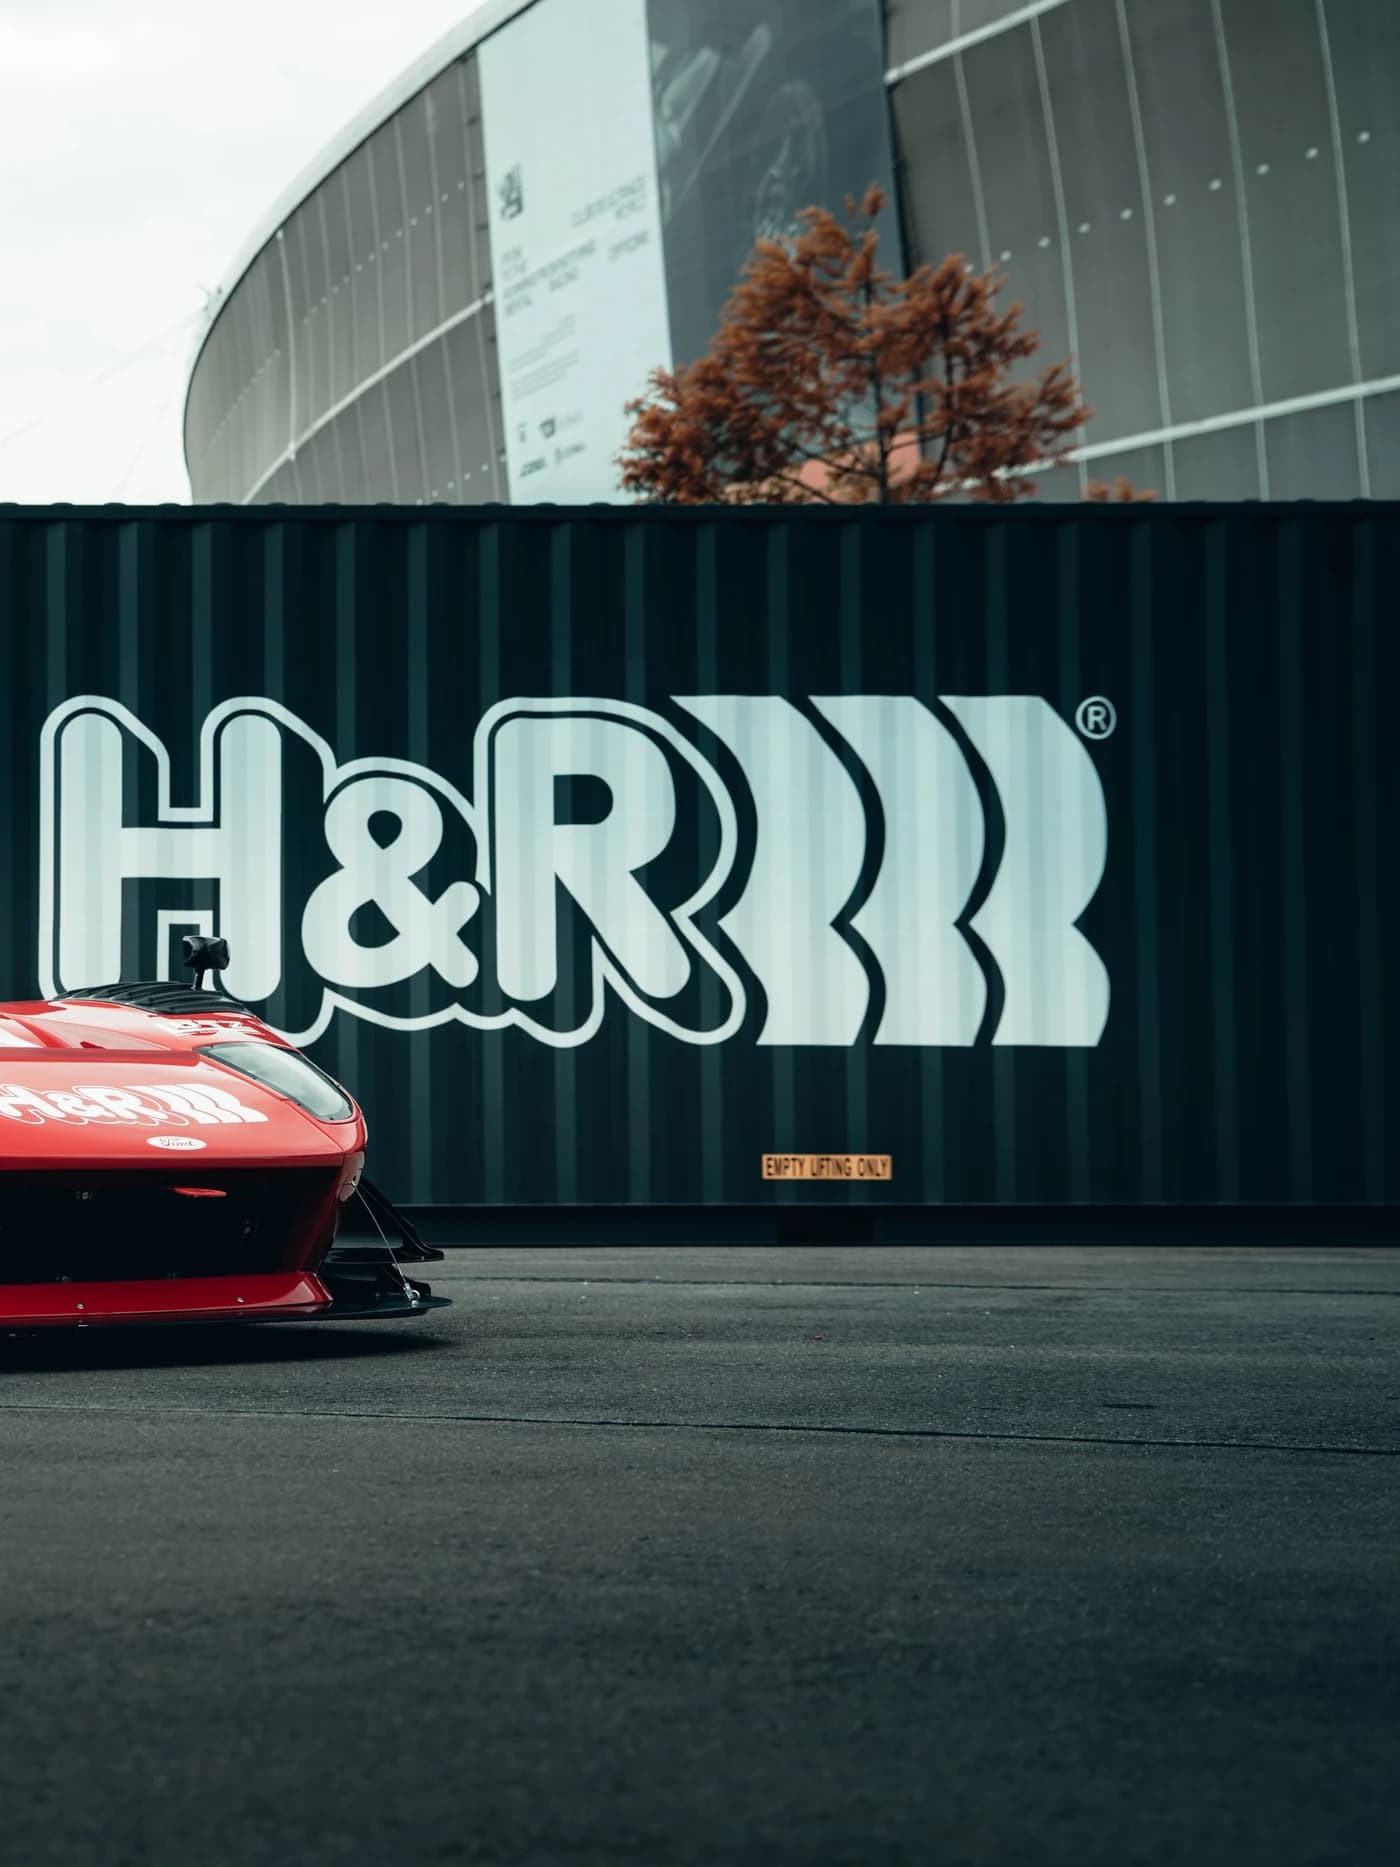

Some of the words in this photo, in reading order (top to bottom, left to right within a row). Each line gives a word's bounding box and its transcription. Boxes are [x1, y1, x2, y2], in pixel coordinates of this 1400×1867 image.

[40, 694, 746, 1048] H&R
[766, 1157, 806, 1177] EMPTY
[810, 1157, 852, 1177] LIFTING
[856, 1157, 889, 1177] ONLY
